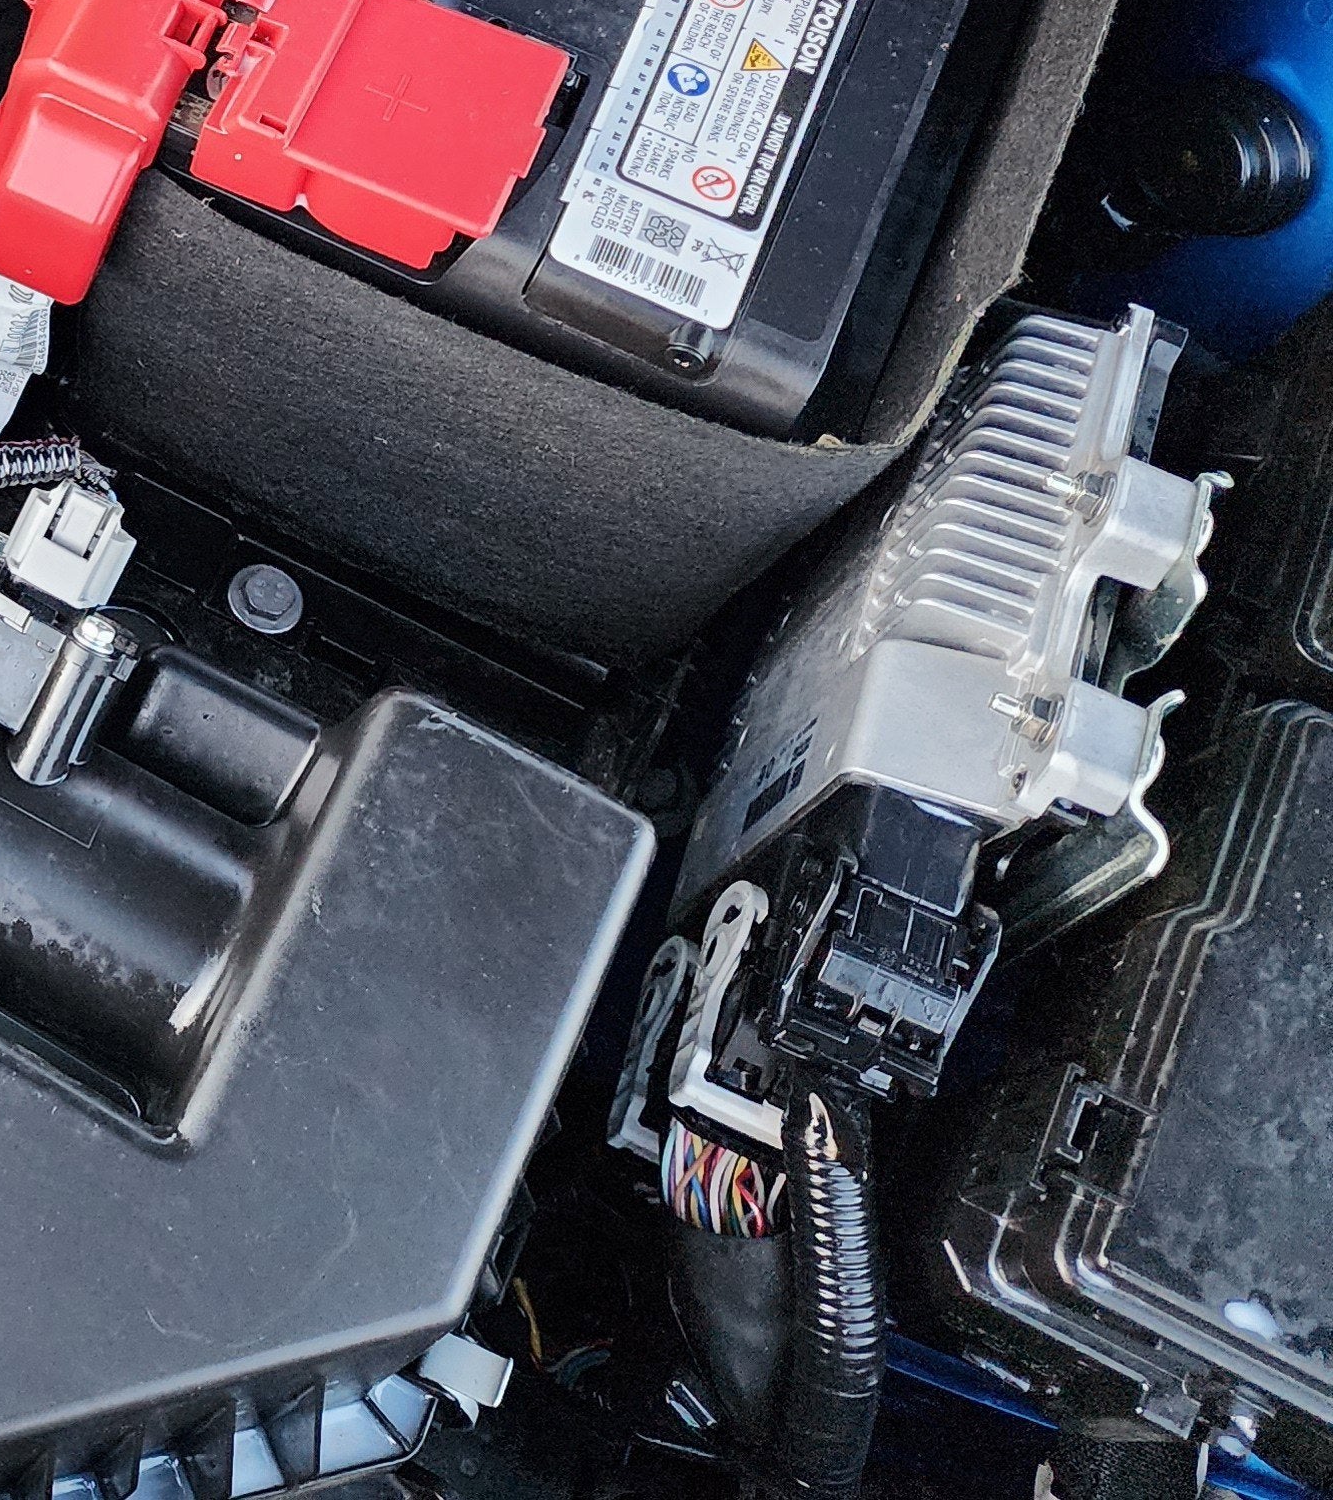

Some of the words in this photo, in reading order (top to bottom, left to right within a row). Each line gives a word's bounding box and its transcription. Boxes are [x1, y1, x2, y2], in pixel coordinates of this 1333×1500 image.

[707, 6, 724, 24] THE
[718, 11, 737, 33] KEEP
[696, 21, 717, 50] REACH
[712, 31, 729, 50] OUT
[729, 71, 745, 86] OR
[741, 71, 762, 99] CAUSE
[717, 83, 740, 115] SEVERE
[750, 71, 781, 121] SULFURIC
[681, 100, 700, 124] READ
[723, 96, 752, 144] BLINDNESS
[769, 111, 793, 134] DO
[741, 116, 763, 143] ACID
[761, 128, 786, 156] NOT
[626, 135, 653, 178] SMOKING
[643, 141, 667, 176] FLAMES
[657, 147, 680, 181] SPARKS
[679, 146, 698, 165] NO
[734, 139, 752, 161] CAN
[754, 150, 777, 172] TIP
[748, 166, 770, 187] OR
[588, 183, 617, 230] RECYCLED
[608, 193, 629, 221] MUST
[736, 181, 764, 219] OPEN.
[617, 198, 643, 238] BATTERY
[595, 260, 639, 287] 88745
